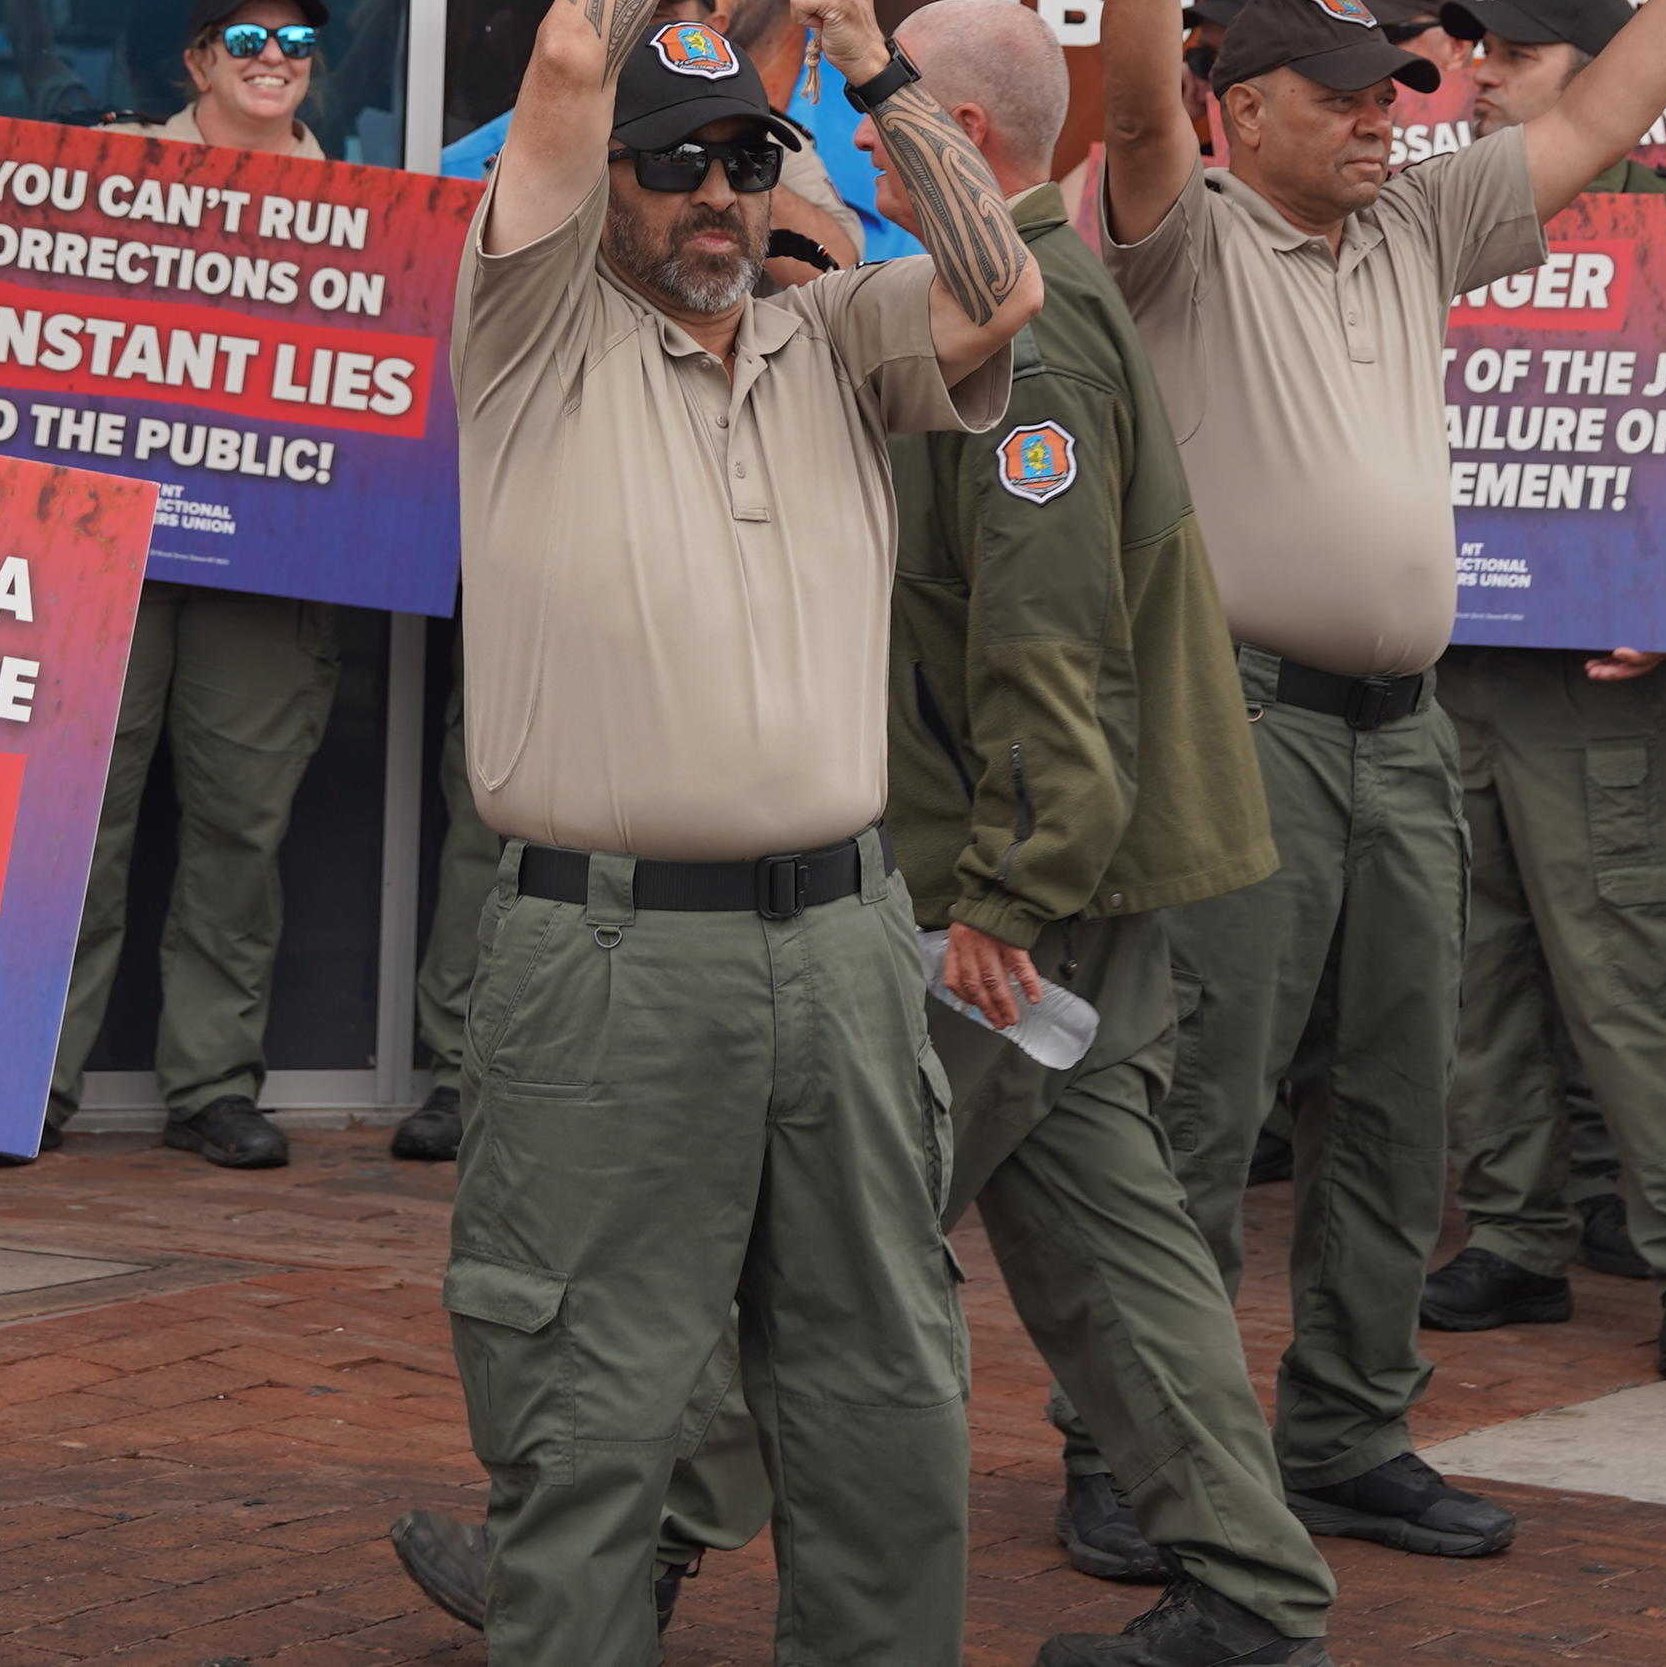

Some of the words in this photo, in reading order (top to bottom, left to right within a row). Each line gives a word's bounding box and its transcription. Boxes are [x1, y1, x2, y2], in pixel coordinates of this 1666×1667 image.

[99, 176, 250, 232] CAN'T
[259, 196, 368, 249] RUN
[310, 268, 384, 315] ON
[1450, 254, 1614, 308] GER
[272, 344, 414, 414] LIES
[1465, 349, 1531, 392] OF
[1543, 350, 1636, 395] THE
[31, 405, 126, 455] THE
[135, 419, 334, 483] PUBLIC!
[1445, 405, 1607, 452] AILURE
[156, 498, 232, 519] ECTIONAL
[161, 484, 185, 498] NT
[1451, 462, 1631, 512] EMENT!
[181, 515, 236, 535] UNION
[1455, 557, 1528, 572] ECTIONAL
[1461, 542, 1484, 556] NT
[1480, 573, 1532, 588] UNION
